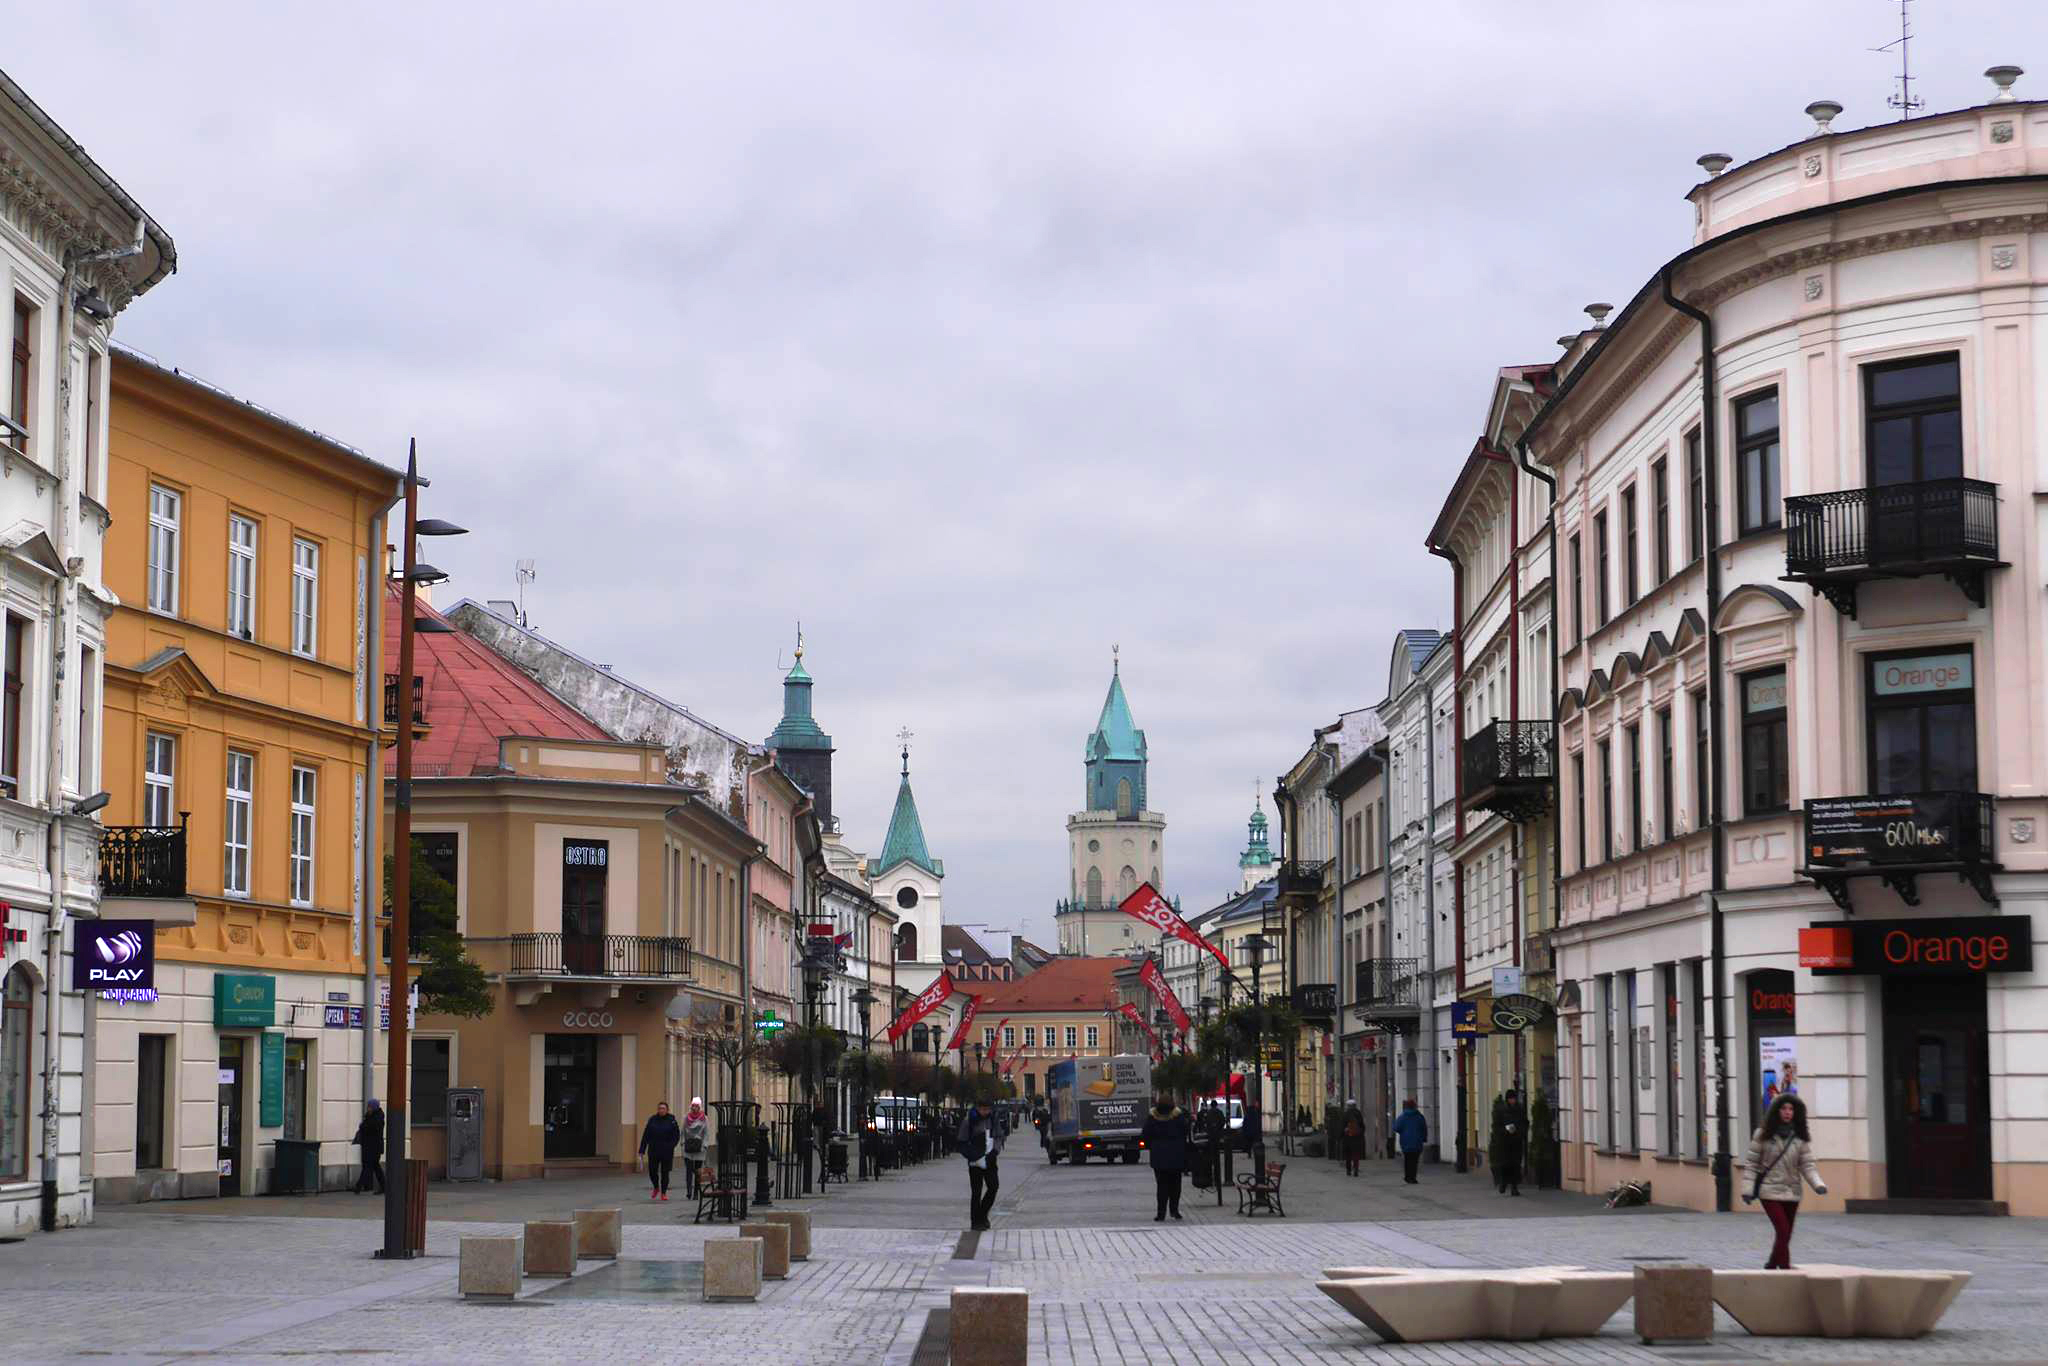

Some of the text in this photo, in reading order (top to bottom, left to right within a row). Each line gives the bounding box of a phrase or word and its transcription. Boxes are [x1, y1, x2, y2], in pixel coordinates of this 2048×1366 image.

[1885, 666, 1960, 687] Orange
[1751, 687, 1786, 705] Orang
[1886, 821, 1915, 847] 600
[565, 846, 606, 866] OSTRO
[1884, 930, 2009, 970] Orange
[89, 968, 144, 981] PLAY
[1752, 989, 1795, 1016] Orang
[325, 1008, 344, 1024] APTEKA
[563, 1011, 613, 1028] ecco
[1097, 1105, 1132, 1114] CERMIX
